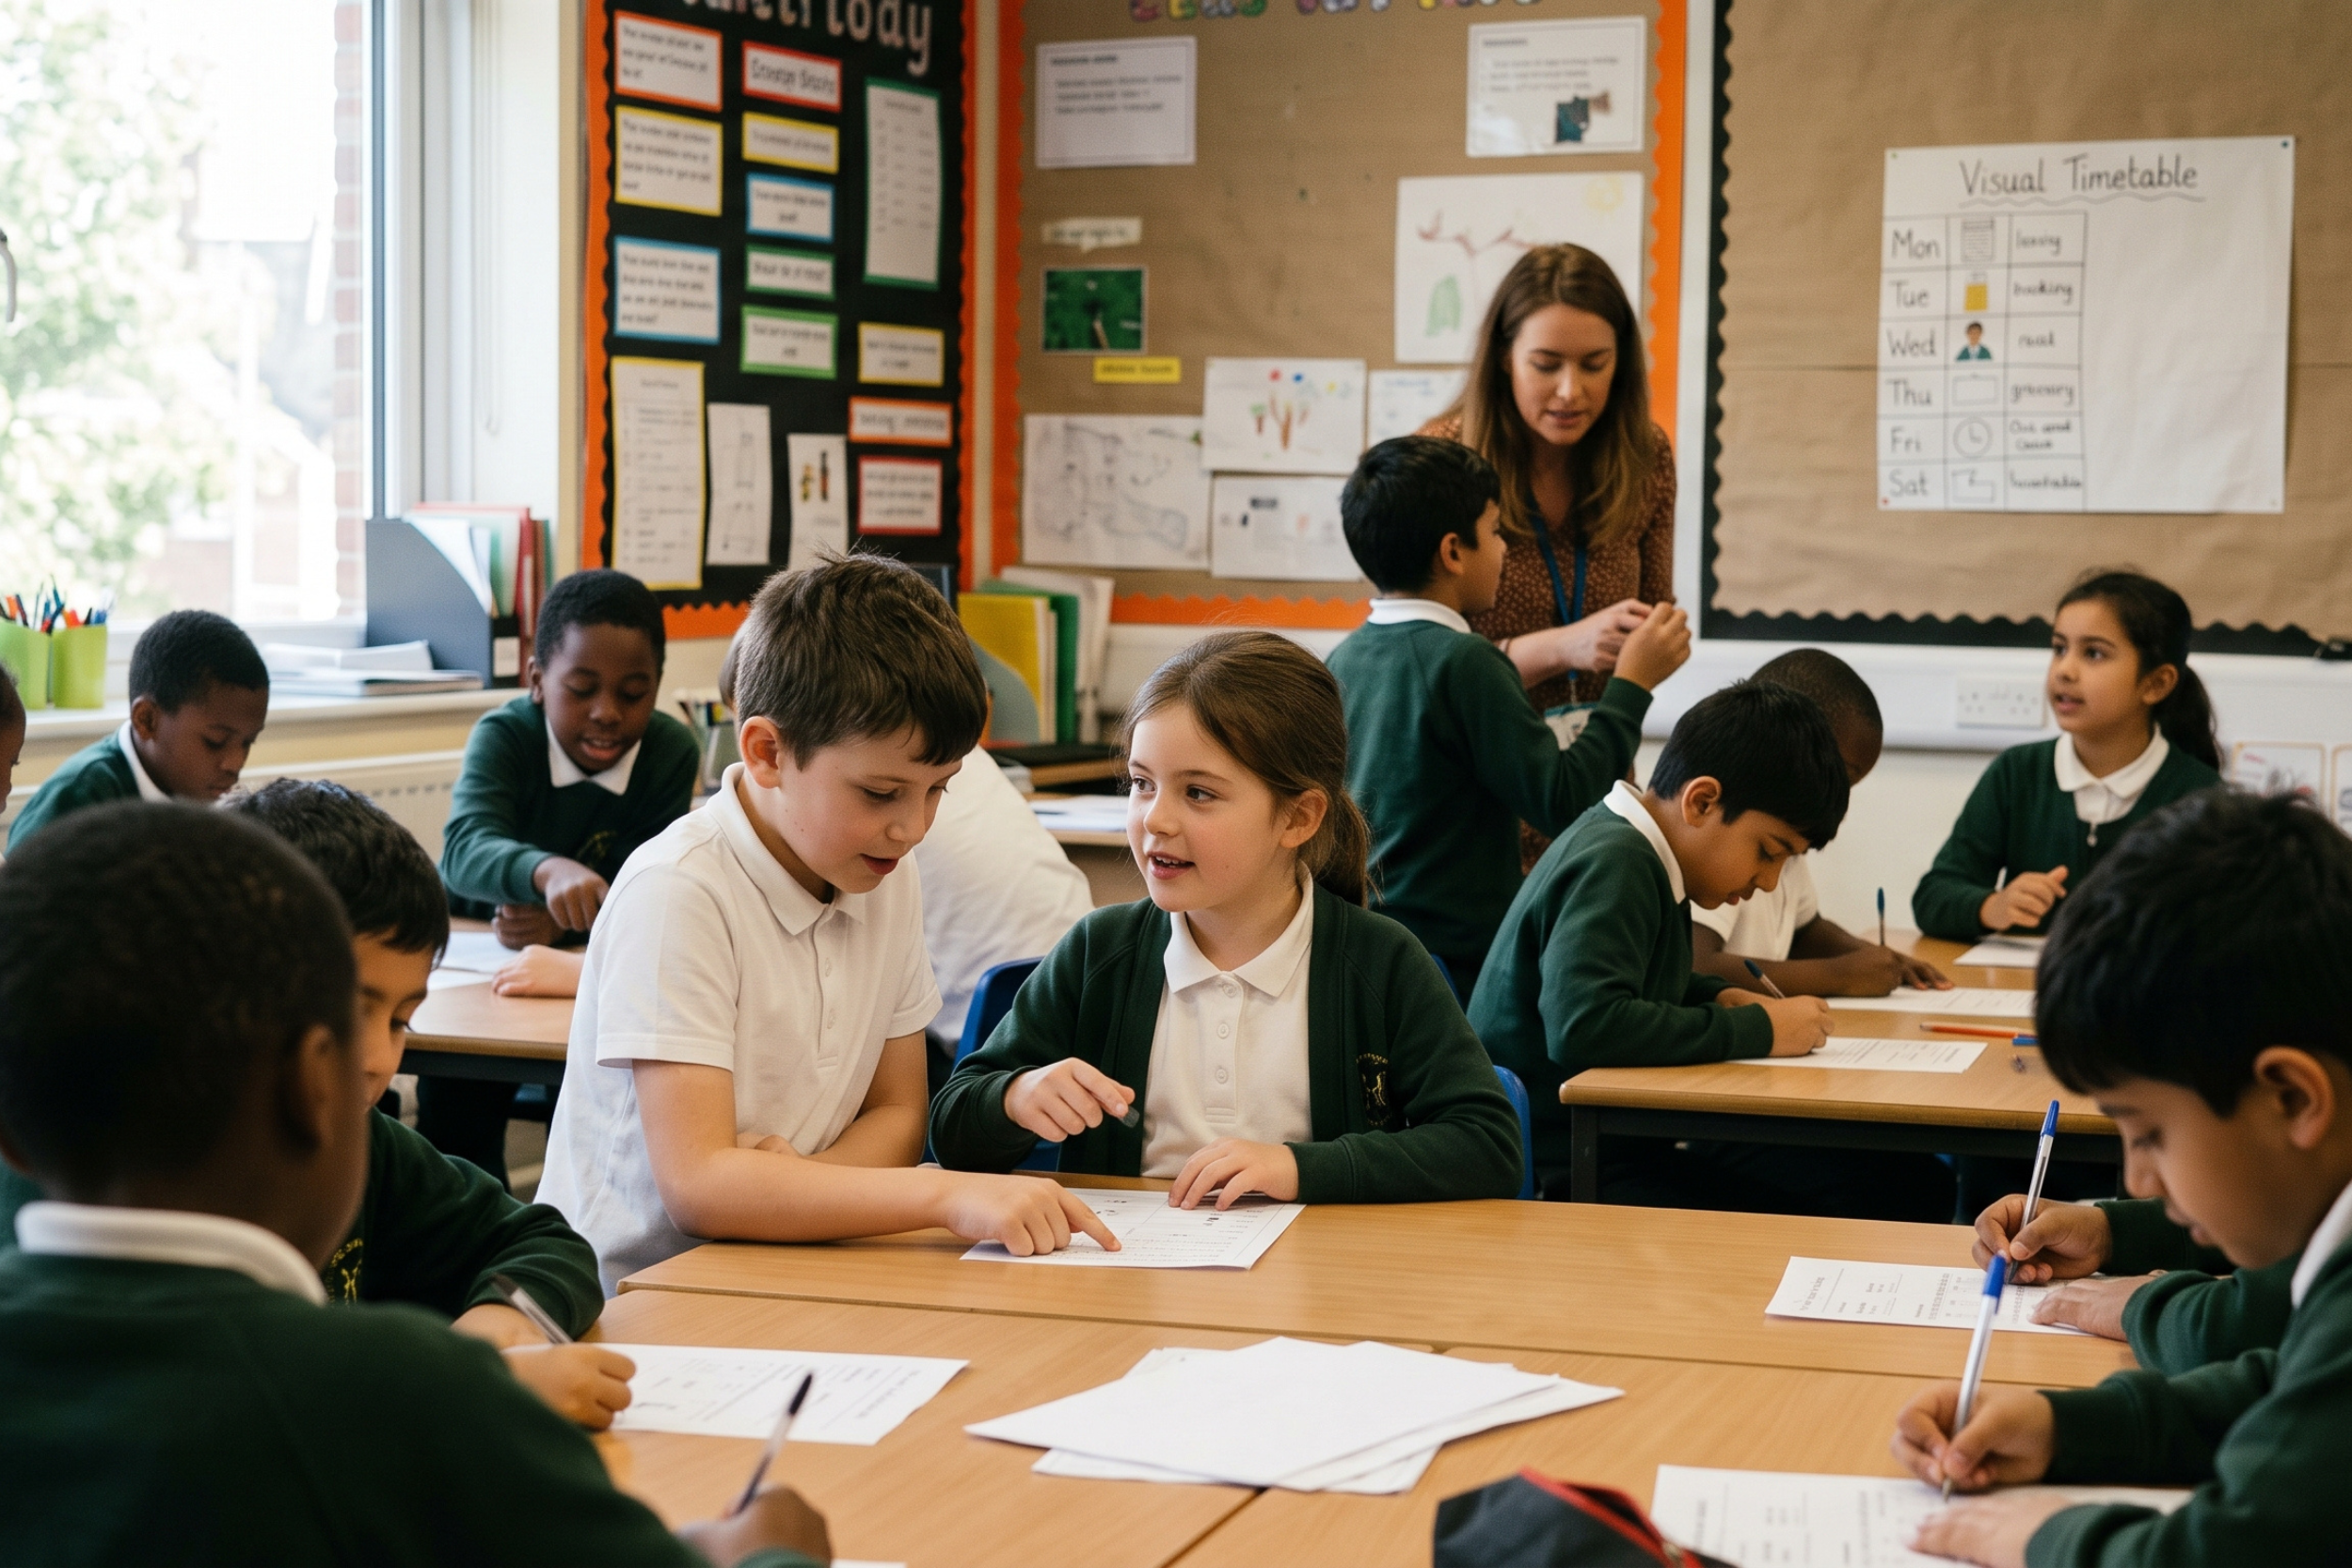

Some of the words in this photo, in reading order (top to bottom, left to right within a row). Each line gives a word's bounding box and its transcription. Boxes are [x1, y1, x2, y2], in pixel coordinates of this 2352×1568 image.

[1959, 158, 2044, 197] Visual
[2062, 152, 2198, 192] Timetable
[1891, 229, 1940, 261] Mon
[1888, 279, 1930, 309] Tue
[1886, 328, 1936, 357] Wed
[1885, 378, 1931, 406] Thu
[1891, 425, 1921, 453] Fri
[1888, 468, 1928, 498] Sat
